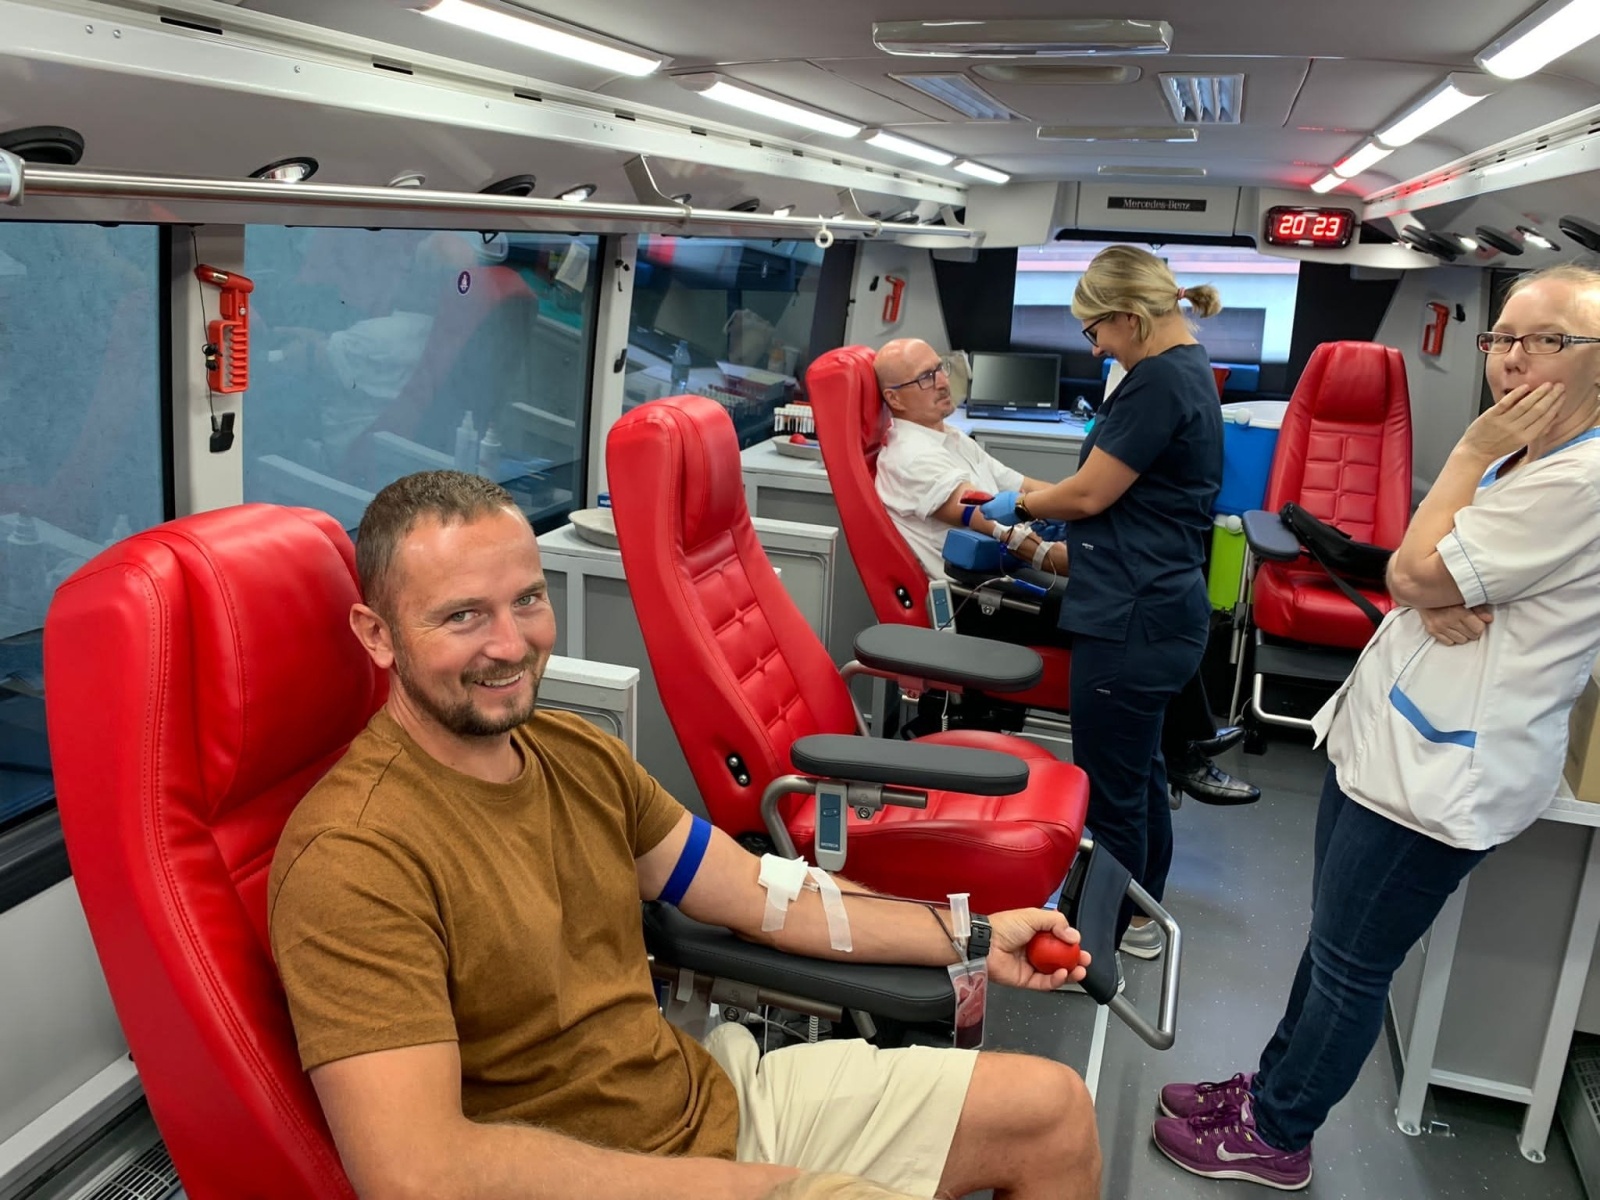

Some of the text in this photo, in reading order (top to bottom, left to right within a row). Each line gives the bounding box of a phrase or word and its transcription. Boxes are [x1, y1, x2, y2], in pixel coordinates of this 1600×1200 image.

[1123, 199, 1191, 210] Mercedes-Benz
[1279, 215, 1340, 236] 20 23
